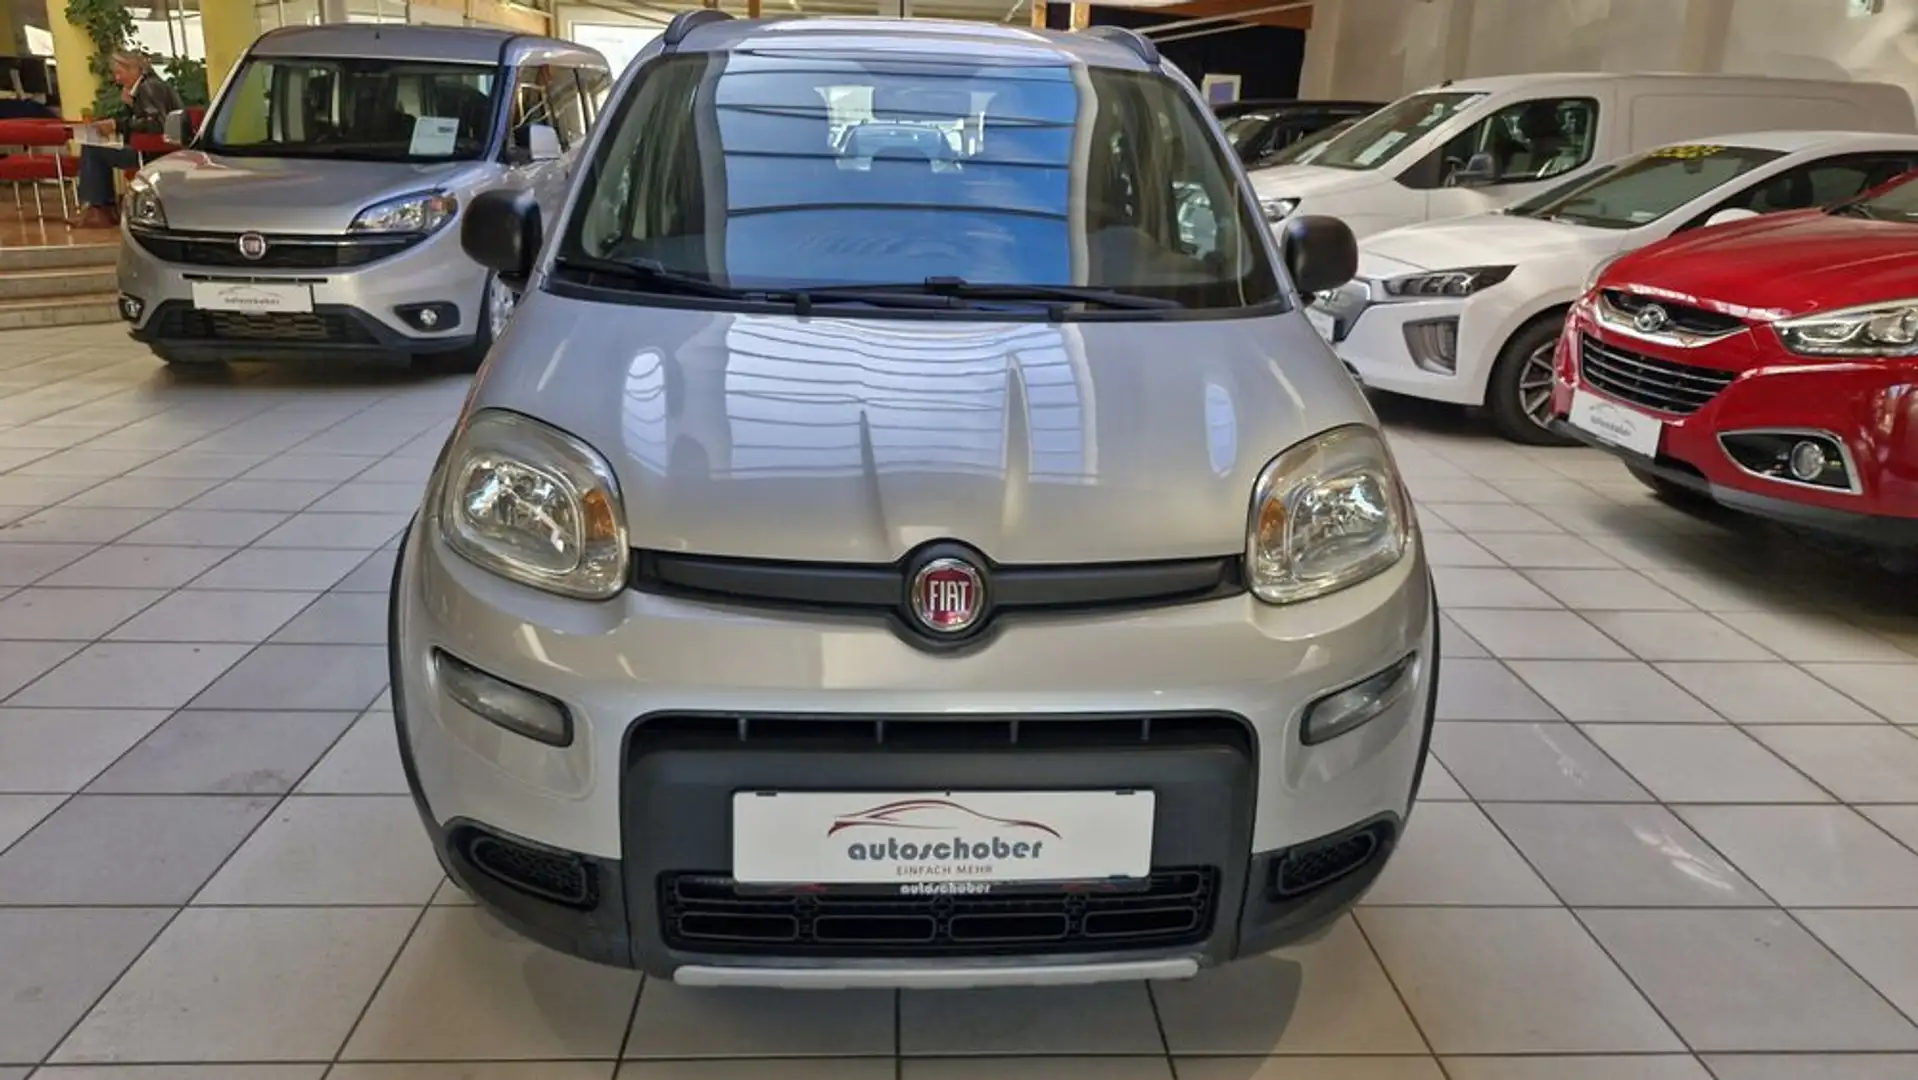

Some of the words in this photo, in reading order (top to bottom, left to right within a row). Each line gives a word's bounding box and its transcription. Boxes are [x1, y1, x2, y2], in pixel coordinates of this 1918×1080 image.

[929, 580, 970, 612] FIAT
[847, 836, 1043, 861] autoschober
[896, 865, 951, 876] EINFACH
[956, 864, 993, 875] MEHR
[900, 883, 992, 895] autoschober
